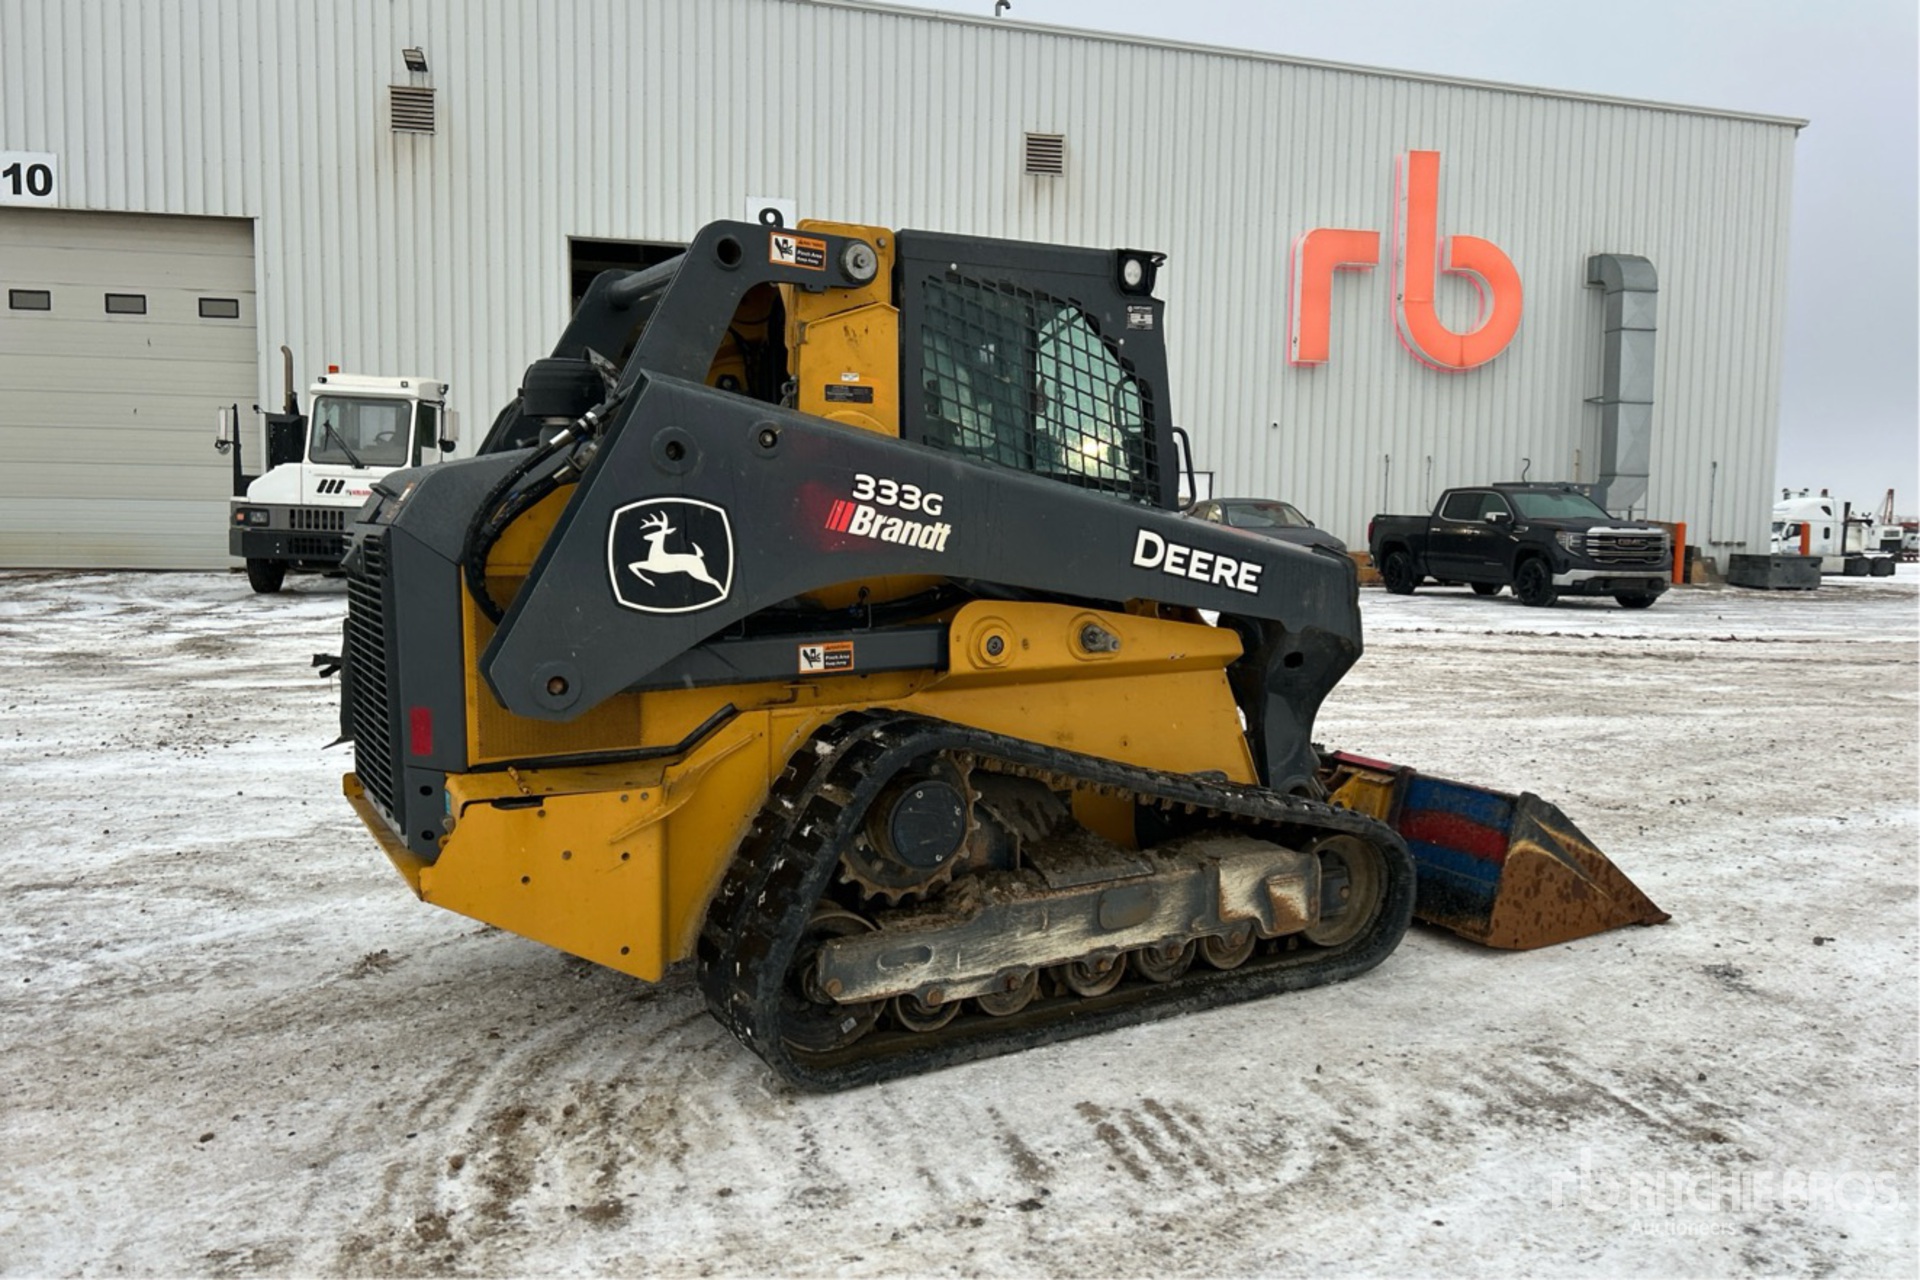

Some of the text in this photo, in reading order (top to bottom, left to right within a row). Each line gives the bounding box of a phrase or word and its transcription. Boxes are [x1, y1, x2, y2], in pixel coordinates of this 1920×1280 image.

[2, 162, 53, 197] 10
[1289, 150, 1523, 371] rb
[852, 473, 944, 516] 333G
[848, 504, 951, 552] Brandt
[1132, 529, 1263, 593] DEERE
